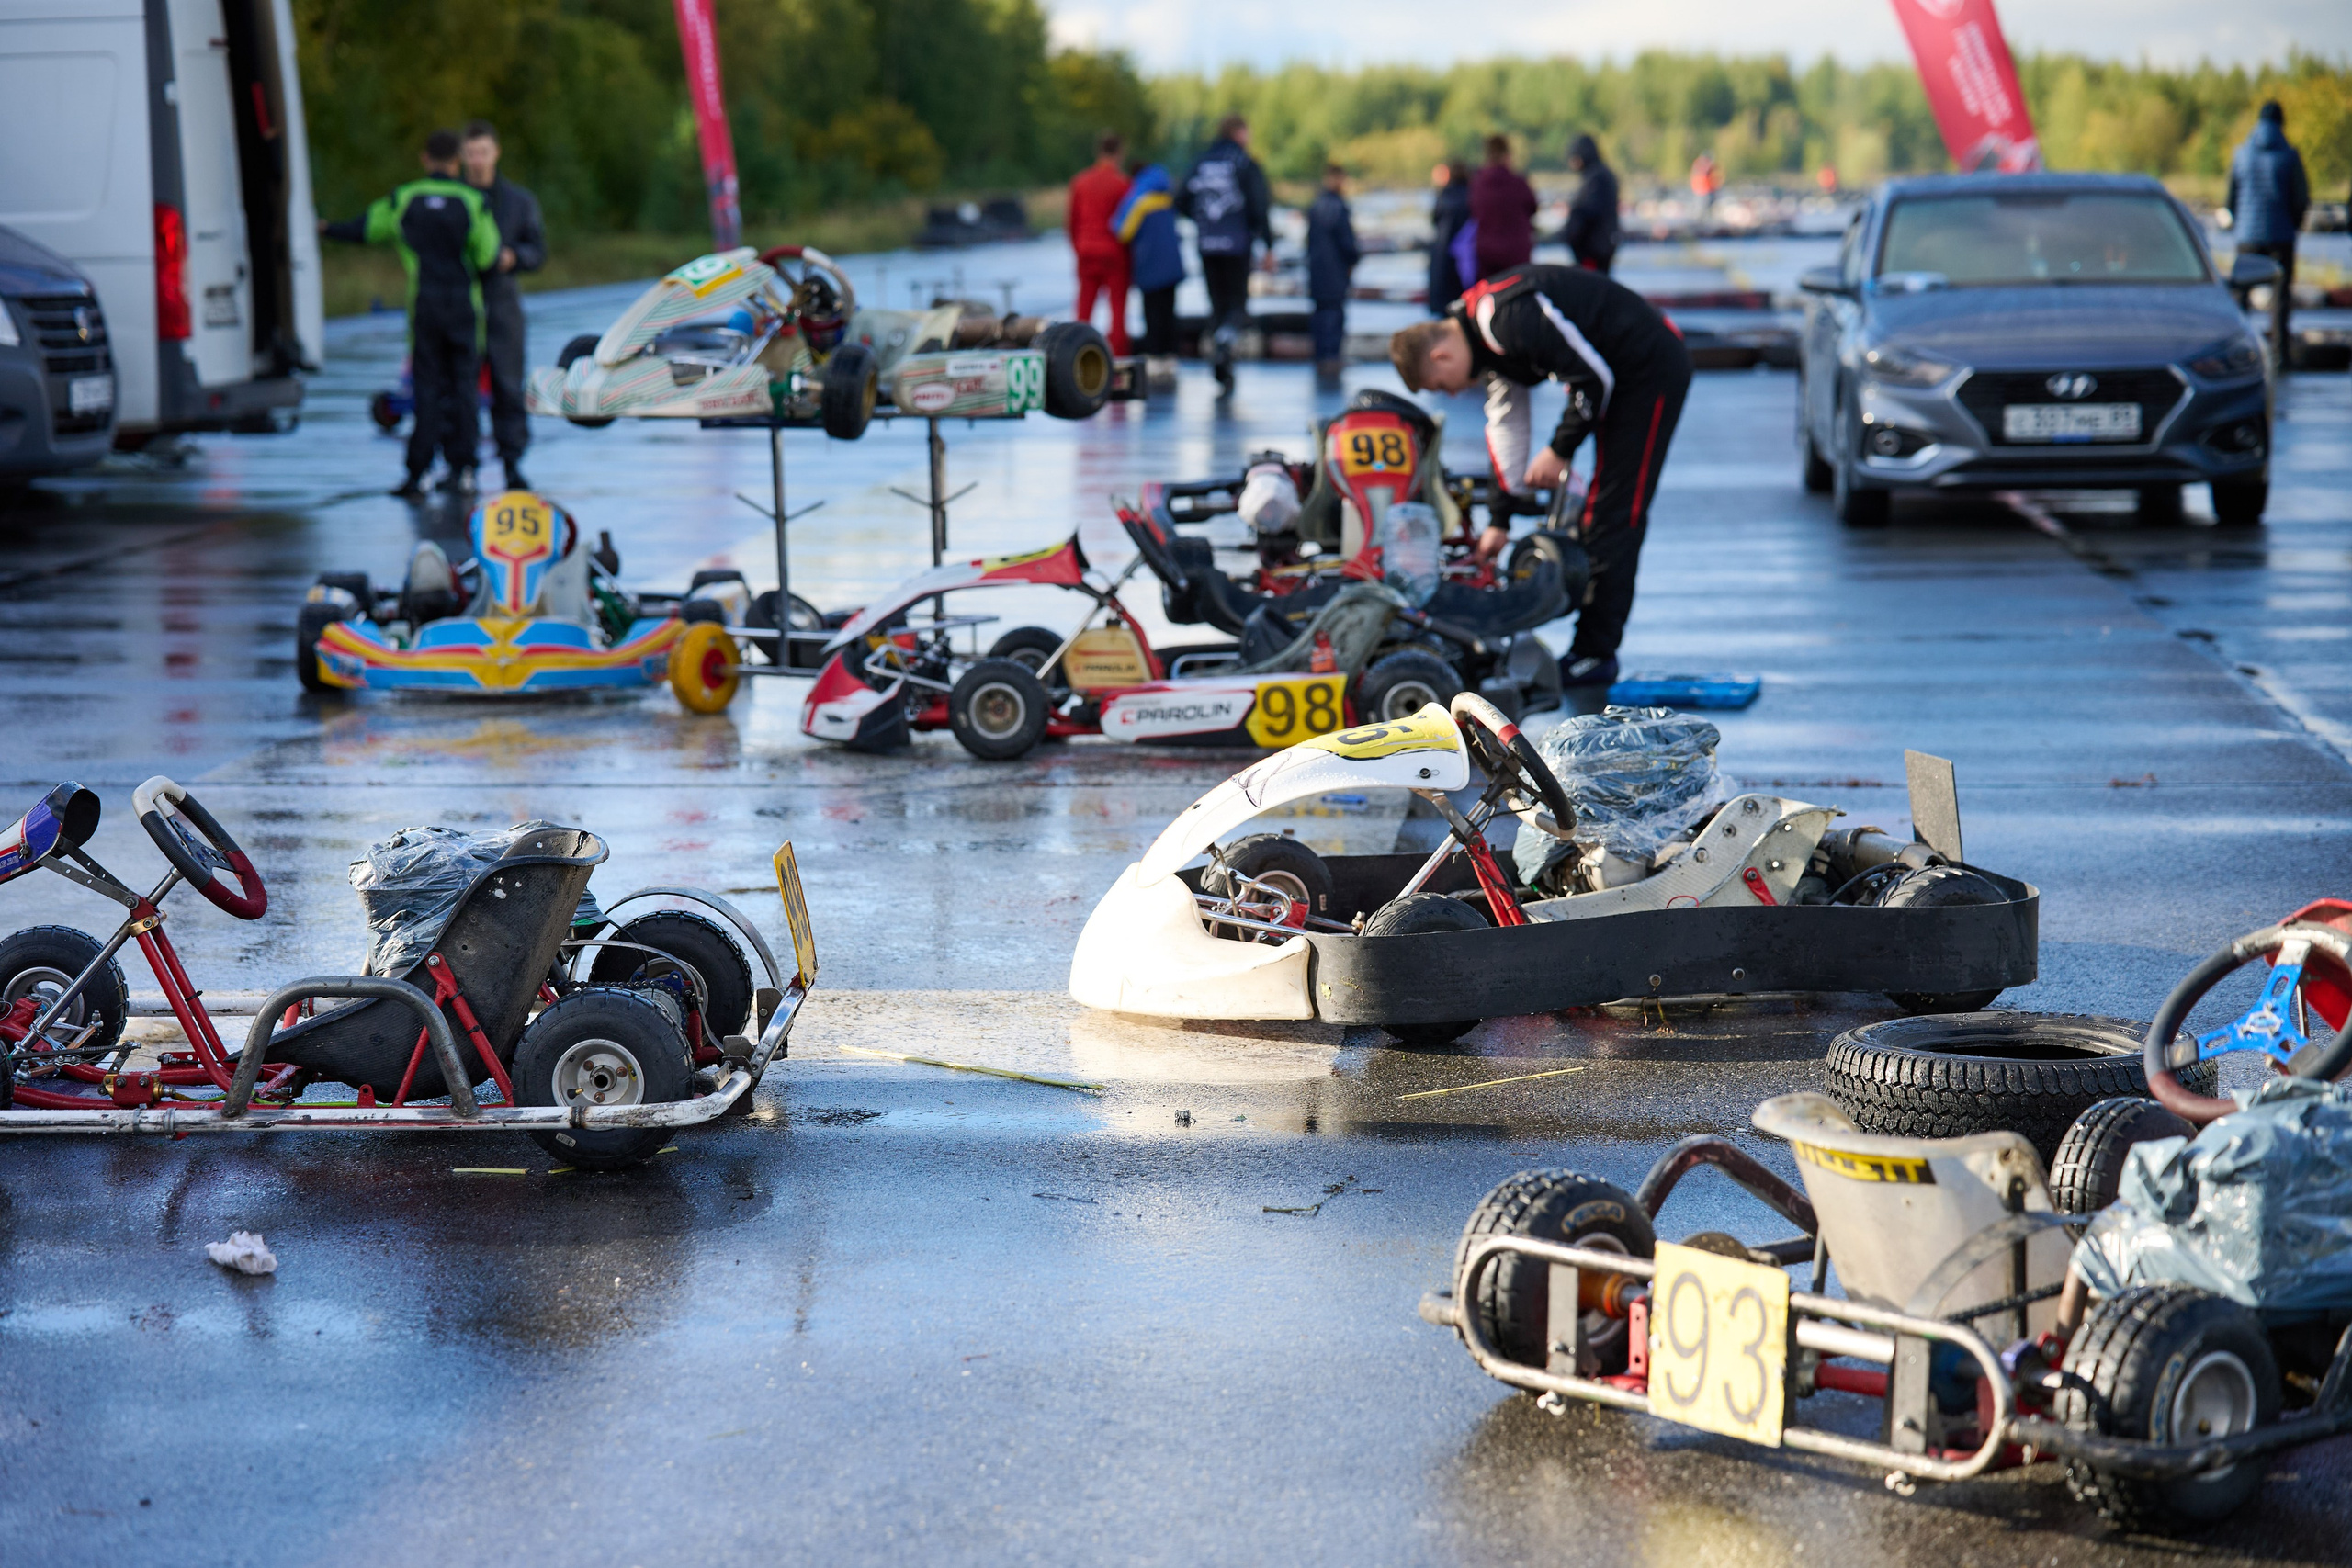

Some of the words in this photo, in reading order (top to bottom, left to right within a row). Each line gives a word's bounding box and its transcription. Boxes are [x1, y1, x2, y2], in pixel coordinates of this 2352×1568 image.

[1010, 357, 1045, 411] 99
[1352, 434, 1406, 467] 98
[496, 507, 540, 536] 95
[1262, 682, 1338, 736] 98
[781, 855, 808, 951] 99
[1565, 1202, 1622, 1231] VEGA
[1666, 1271, 1769, 1425] 93
